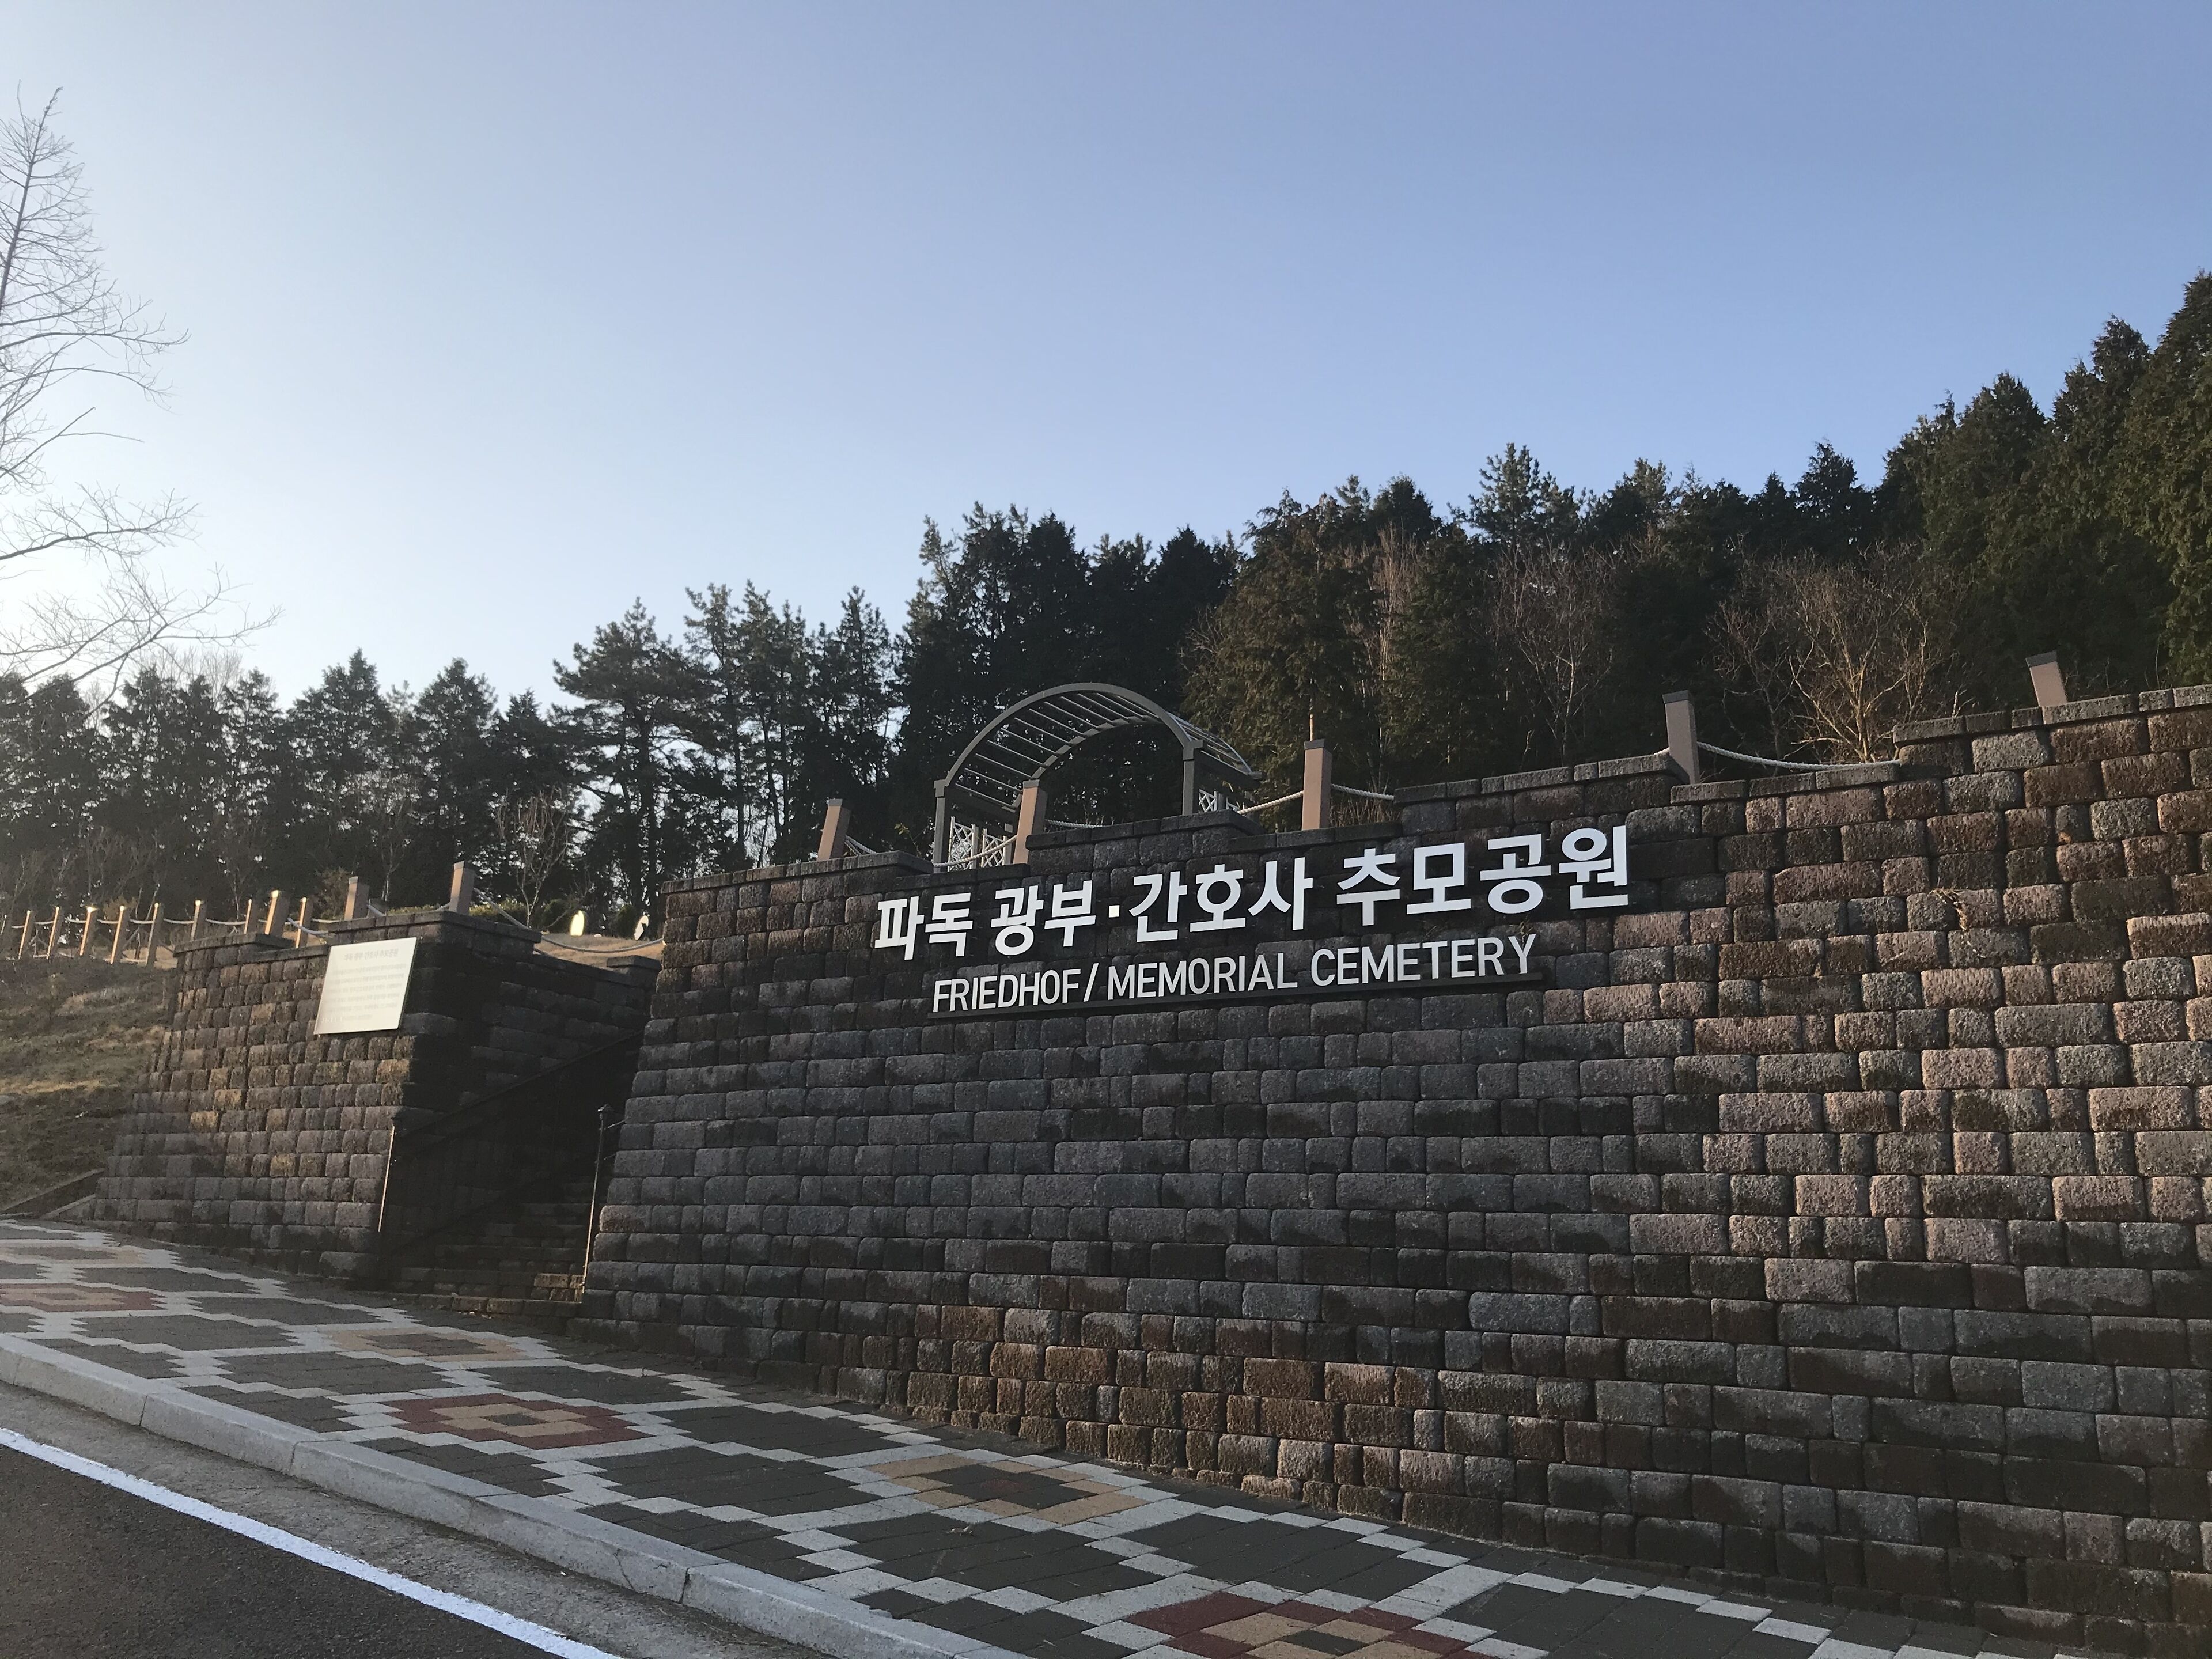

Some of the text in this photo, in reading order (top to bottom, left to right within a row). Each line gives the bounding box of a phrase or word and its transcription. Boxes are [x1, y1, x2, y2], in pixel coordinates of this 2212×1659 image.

[874, 892, 973, 960] 파독
[1336, 825, 1627, 926] 추모공원
[1108, 952, 1298, 1001] MEMORIAL
[1311, 934, 1536, 987] CEMETERY
